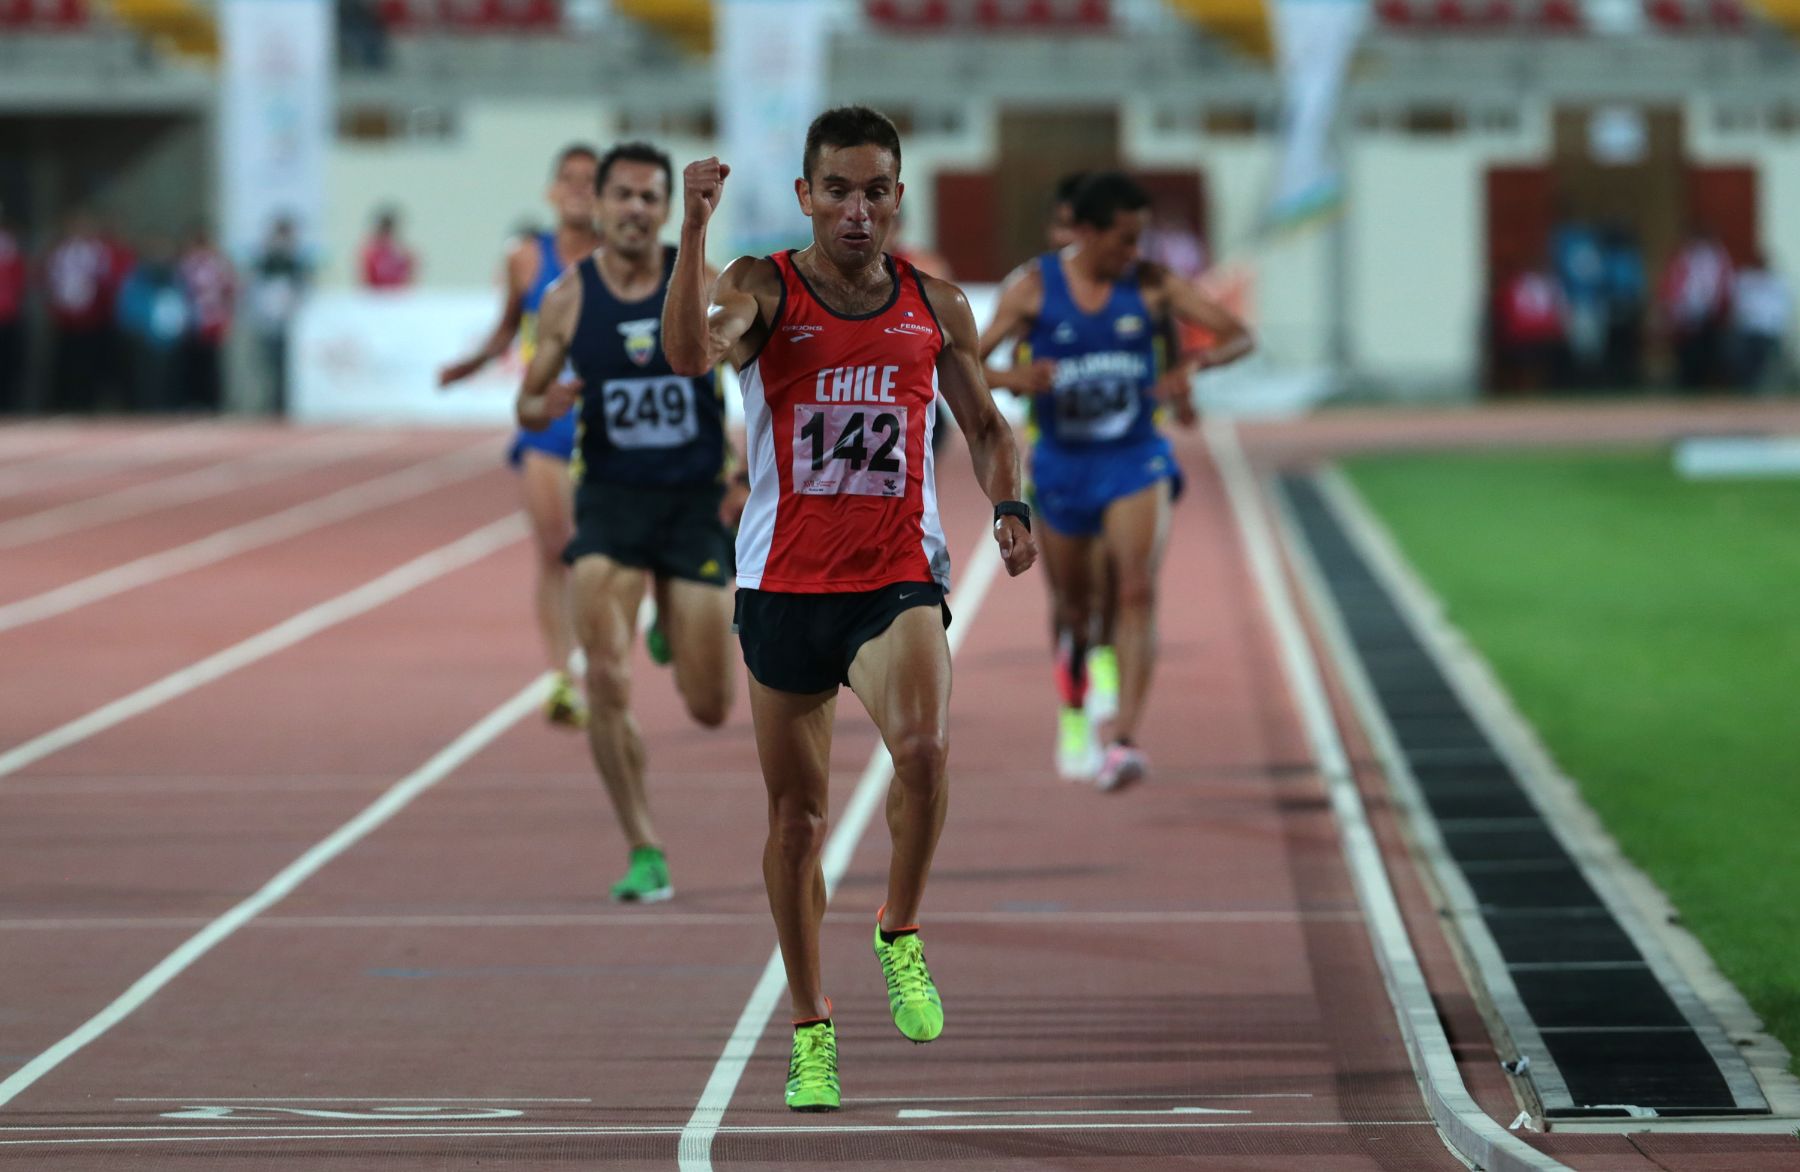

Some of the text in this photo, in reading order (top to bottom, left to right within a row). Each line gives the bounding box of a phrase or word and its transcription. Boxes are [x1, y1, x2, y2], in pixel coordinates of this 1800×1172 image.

[610, 383, 686, 428] 249
[815, 365, 899, 403] CHILE
[801, 411, 900, 472] 142
